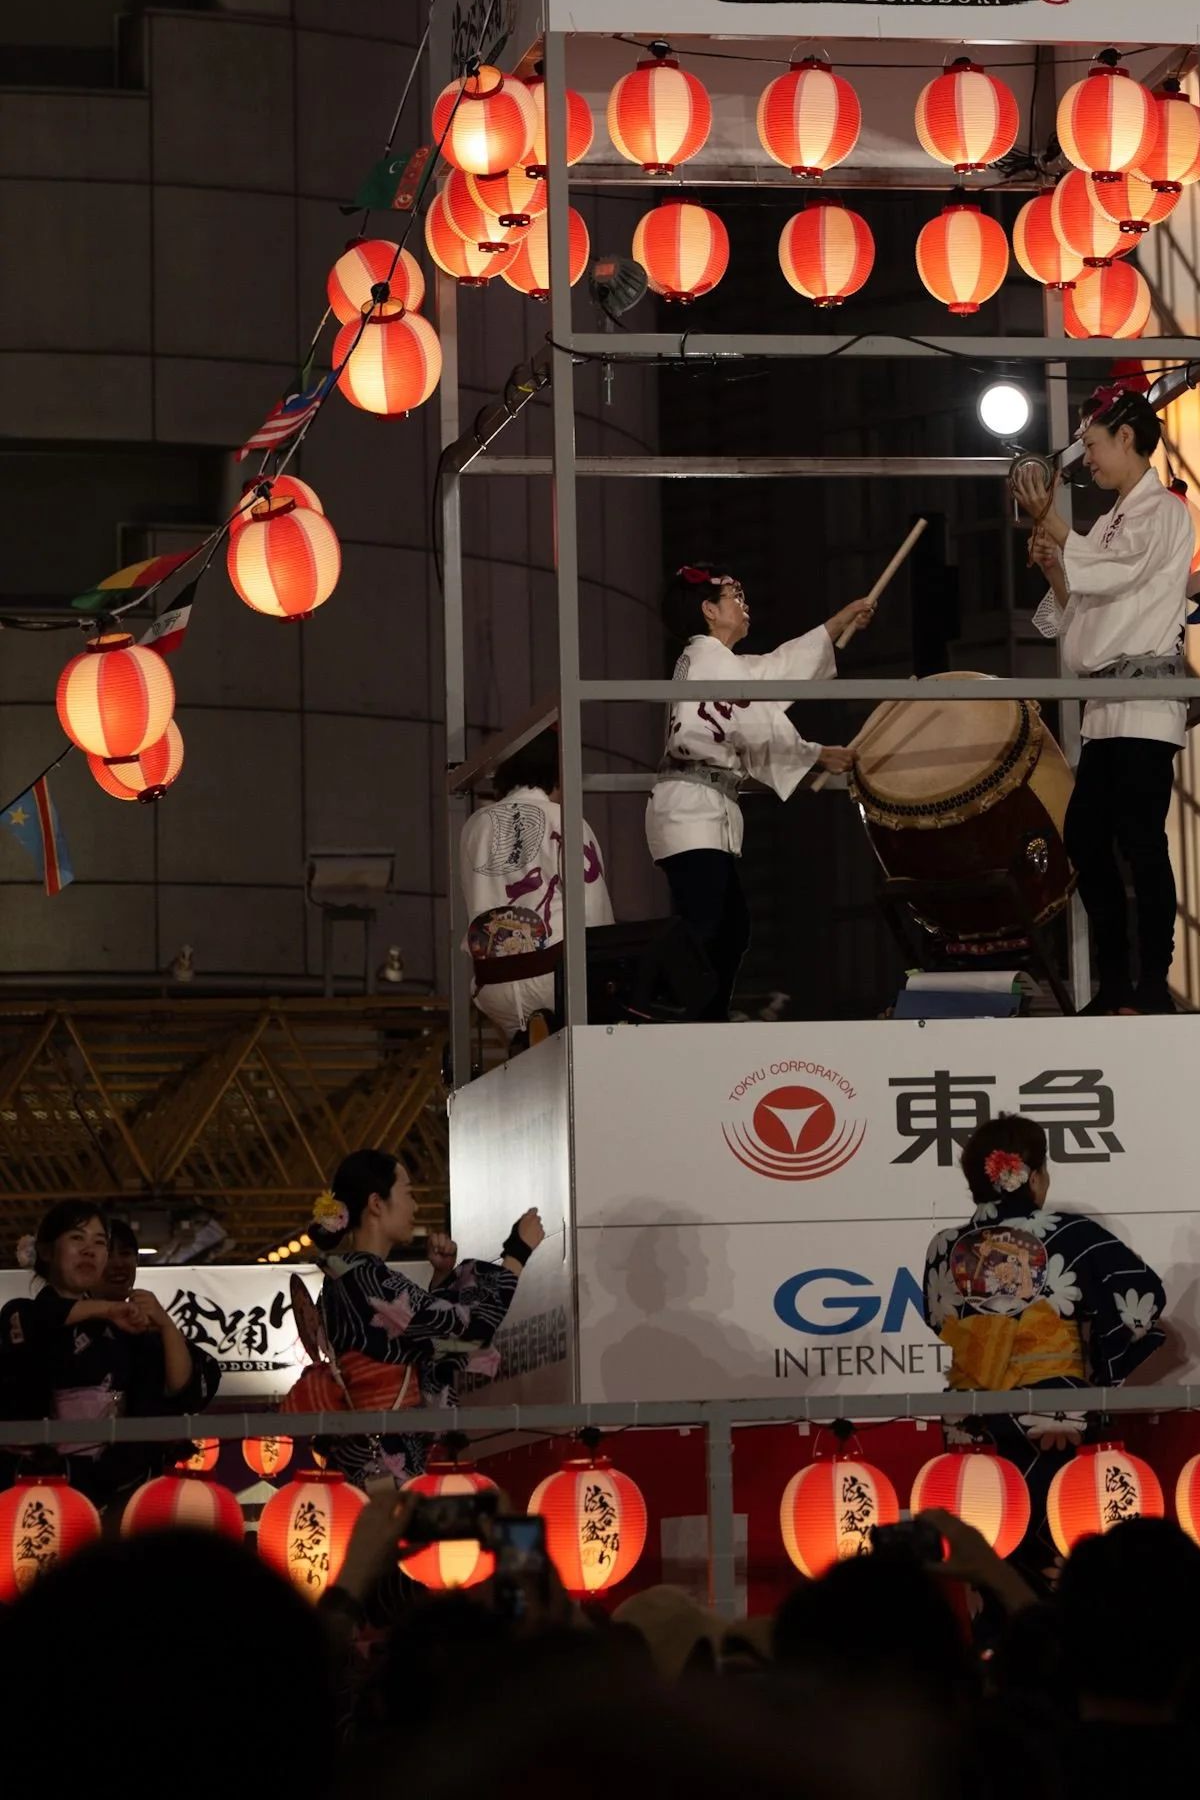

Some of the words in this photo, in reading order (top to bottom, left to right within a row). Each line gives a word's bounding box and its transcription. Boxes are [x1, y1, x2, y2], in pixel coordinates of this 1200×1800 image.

[729, 1068, 766, 1101] TOKYU
[769, 1060, 857, 1100] CORPORATION
[889, 1069, 1126, 1167] 東急
[774, 1343, 950, 1379] INTERNET
